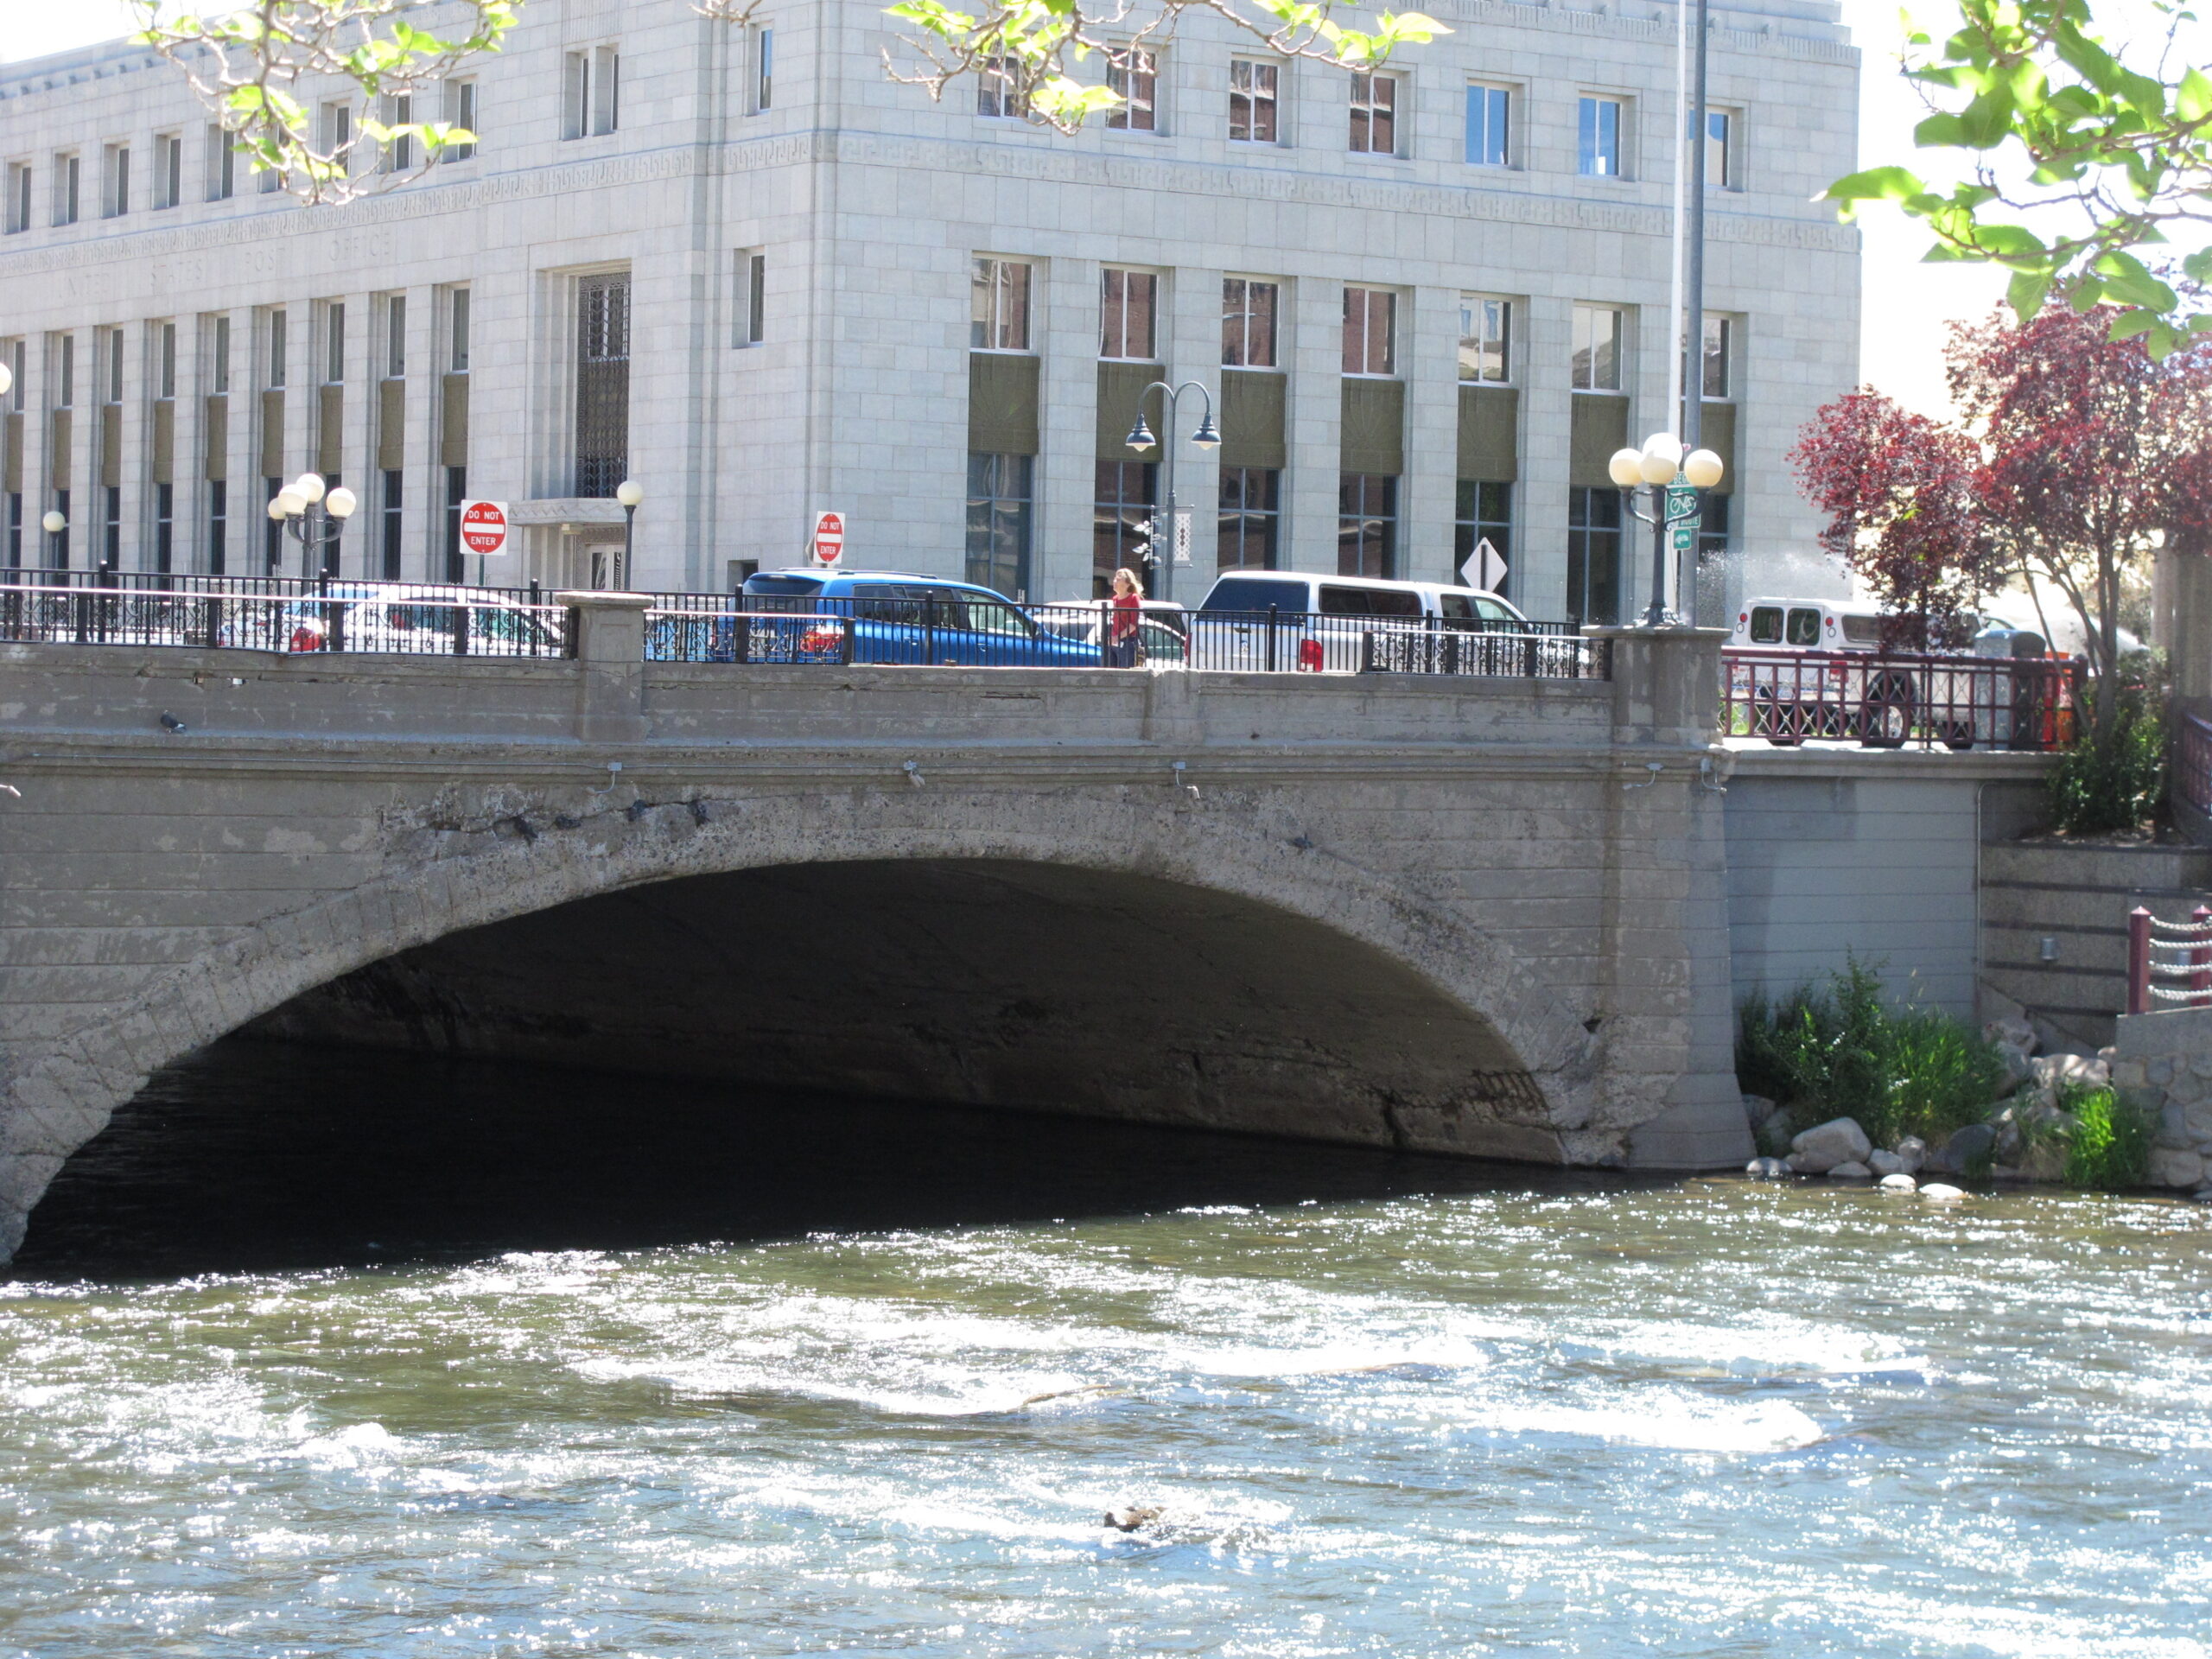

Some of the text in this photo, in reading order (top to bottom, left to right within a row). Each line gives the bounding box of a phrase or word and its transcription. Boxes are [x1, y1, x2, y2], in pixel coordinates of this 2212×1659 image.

[245, 246, 286, 273] POST
[329, 232, 391, 262] OFFICE
[467, 510, 499, 520] DO NOT
[820, 521, 840, 531] DO NOT
[470, 536, 496, 546] ENTER
[820, 545, 836, 555] ENTER
